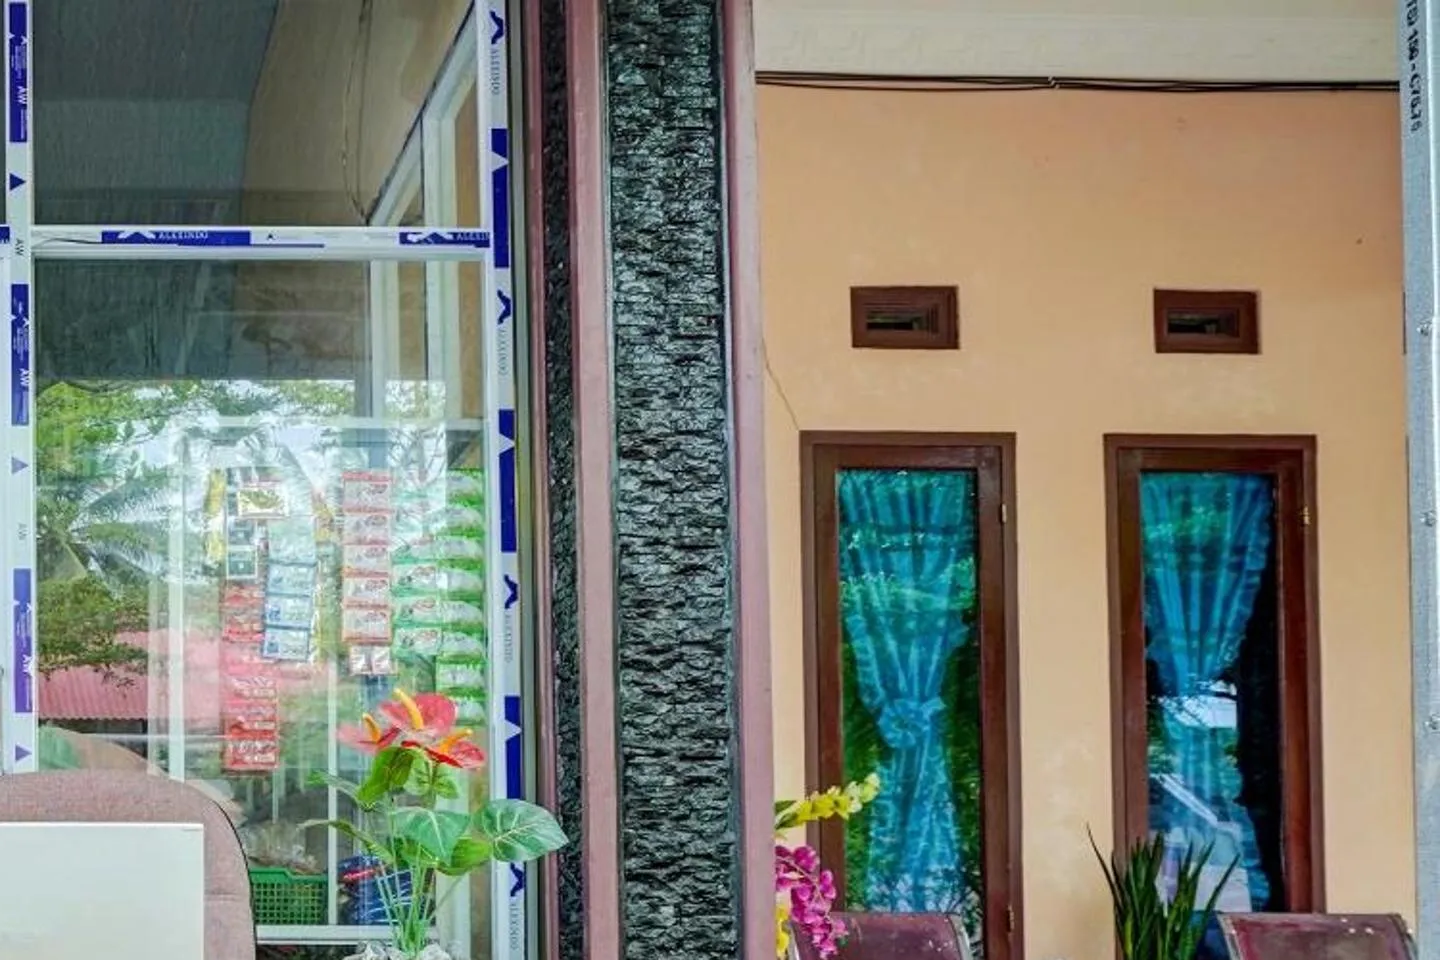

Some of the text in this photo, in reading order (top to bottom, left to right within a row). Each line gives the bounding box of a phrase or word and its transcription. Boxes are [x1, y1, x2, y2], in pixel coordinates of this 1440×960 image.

[16, 86, 29, 105] AW
[15, 238, 25, 257] AW
[19, 368, 31, 388] AW
